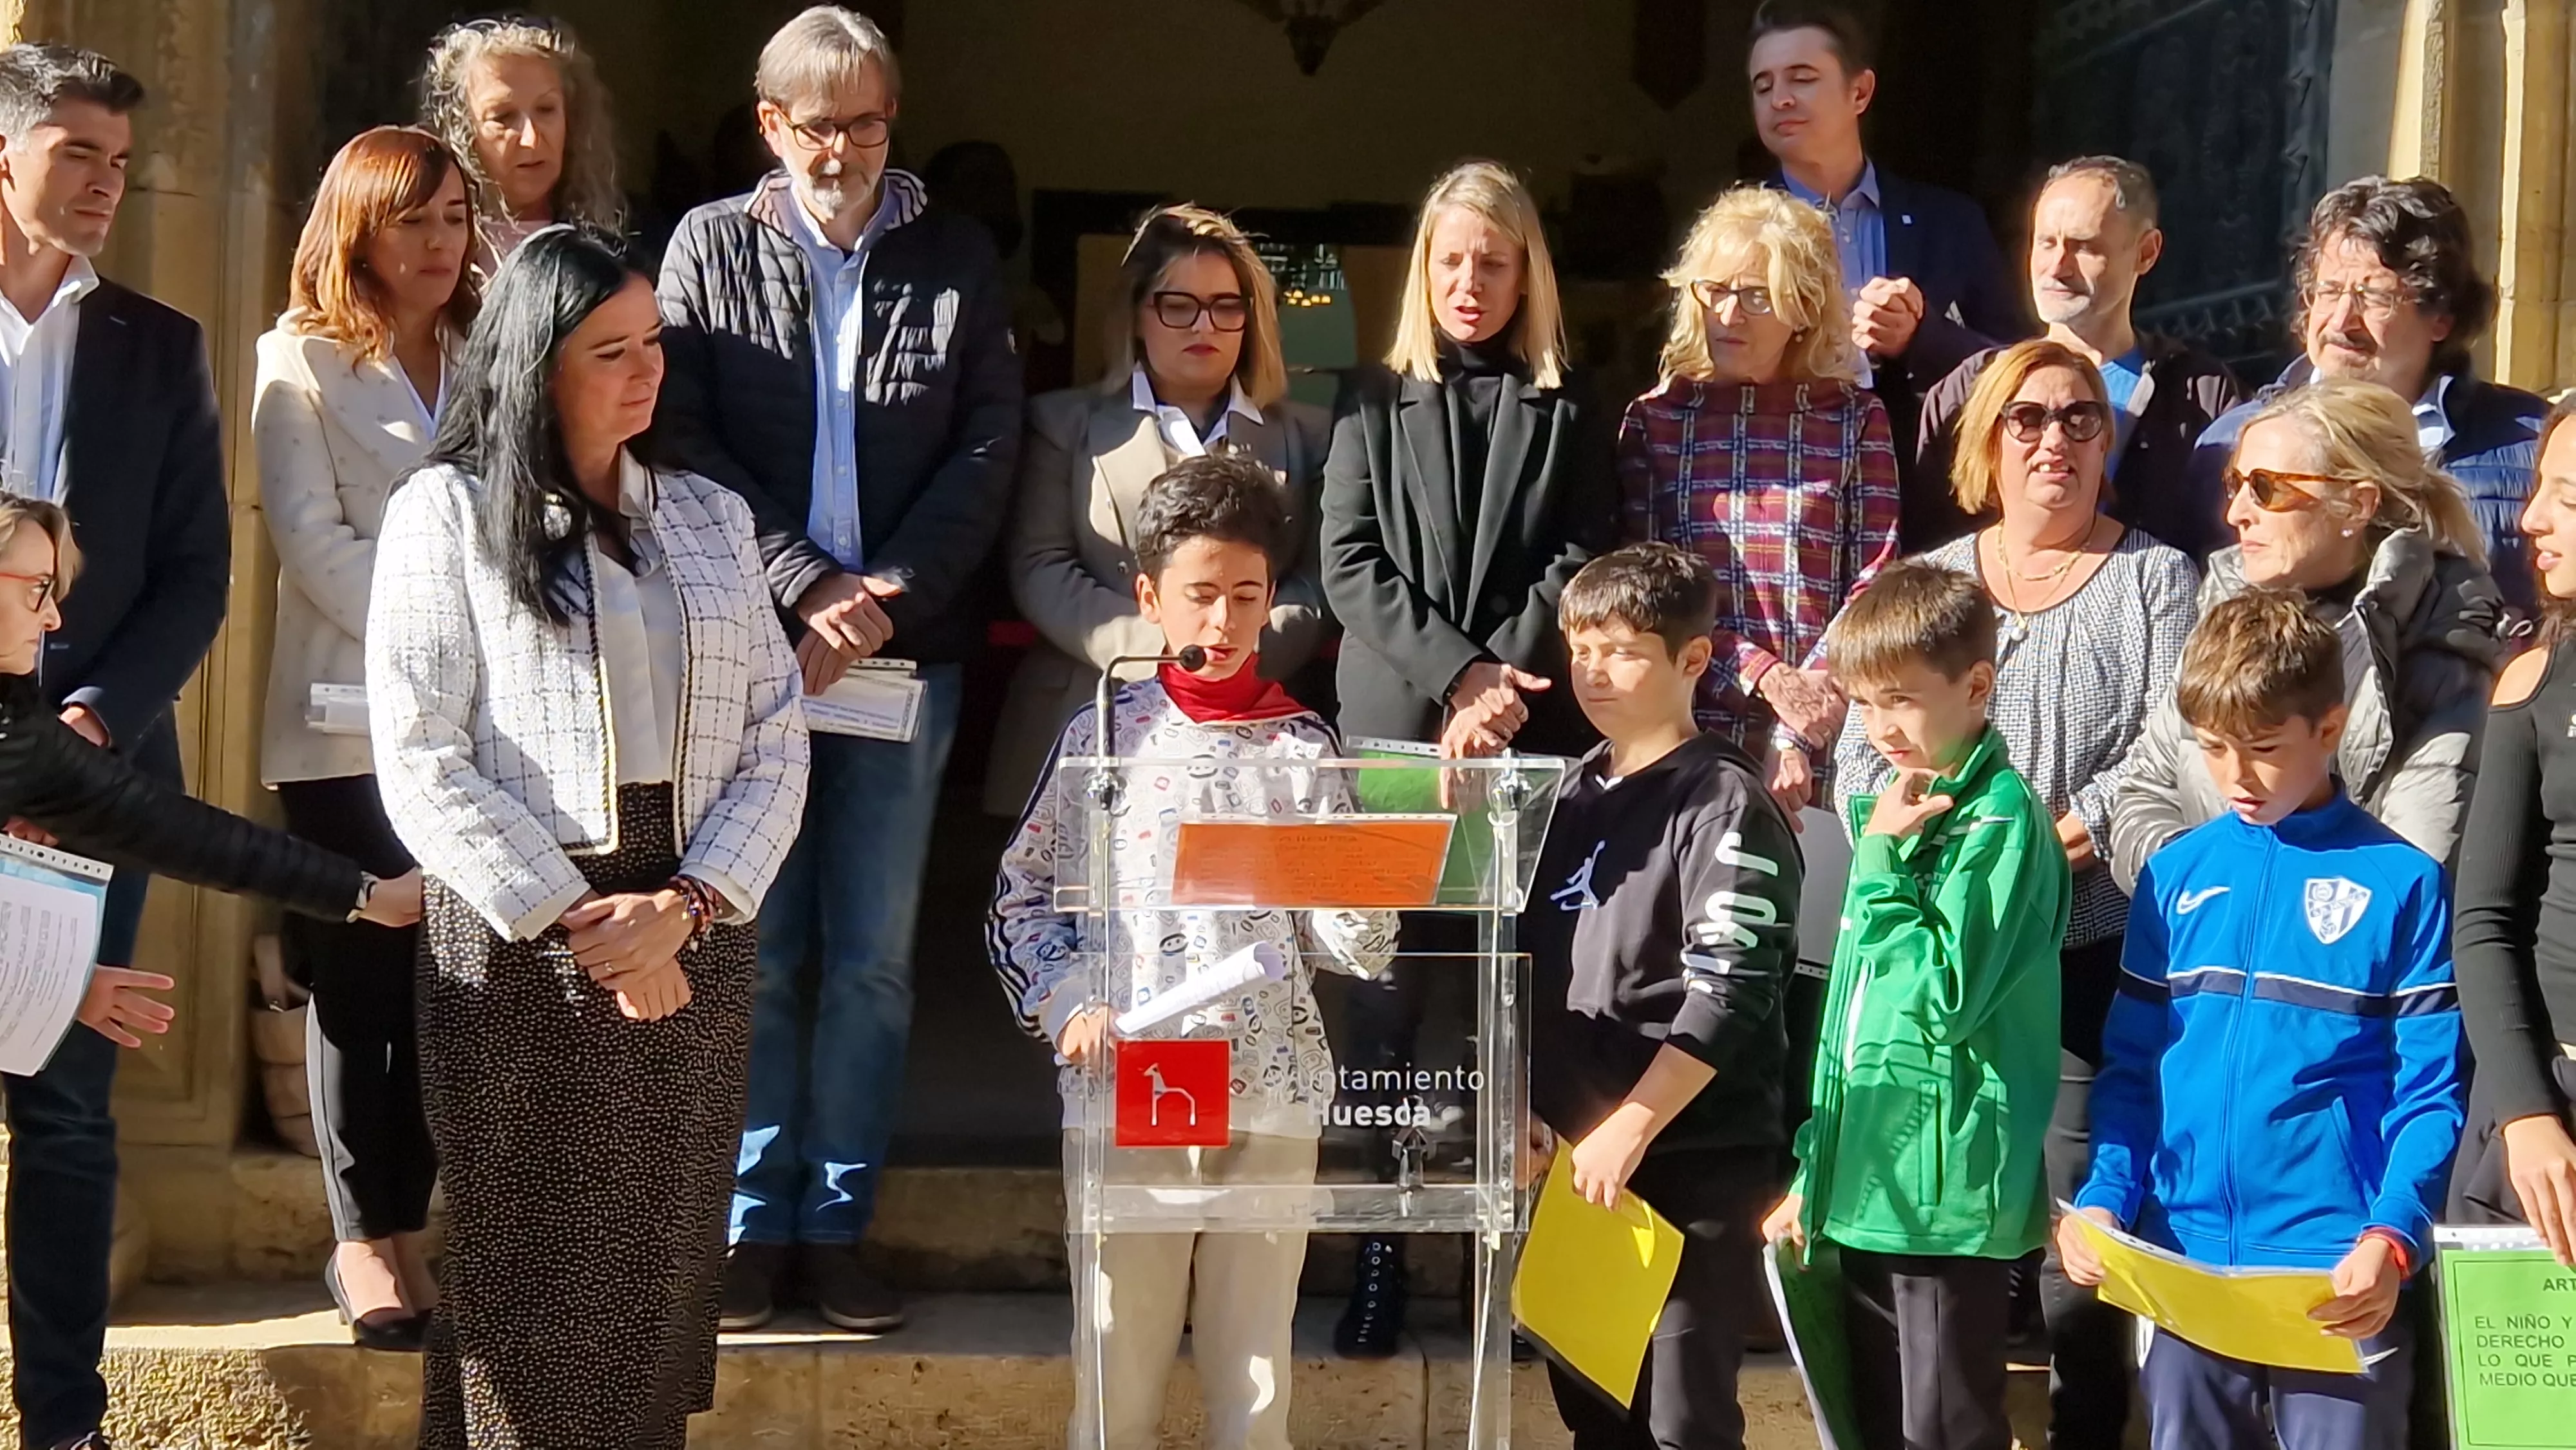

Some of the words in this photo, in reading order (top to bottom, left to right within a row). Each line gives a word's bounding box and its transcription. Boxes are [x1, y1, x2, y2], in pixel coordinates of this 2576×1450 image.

[2474, 1315, 2496, 1330] EL
[2506, 1313, 2551, 1330] NIÑO
[2561, 1315, 2573, 1330] Y
[2476, 1334, 2565, 1349] DERECHO
[2477, 1353, 2501, 1367] LO
[2515, 1353, 2553, 1368] QUE
[2479, 1372, 2537, 1387] MEDIO
